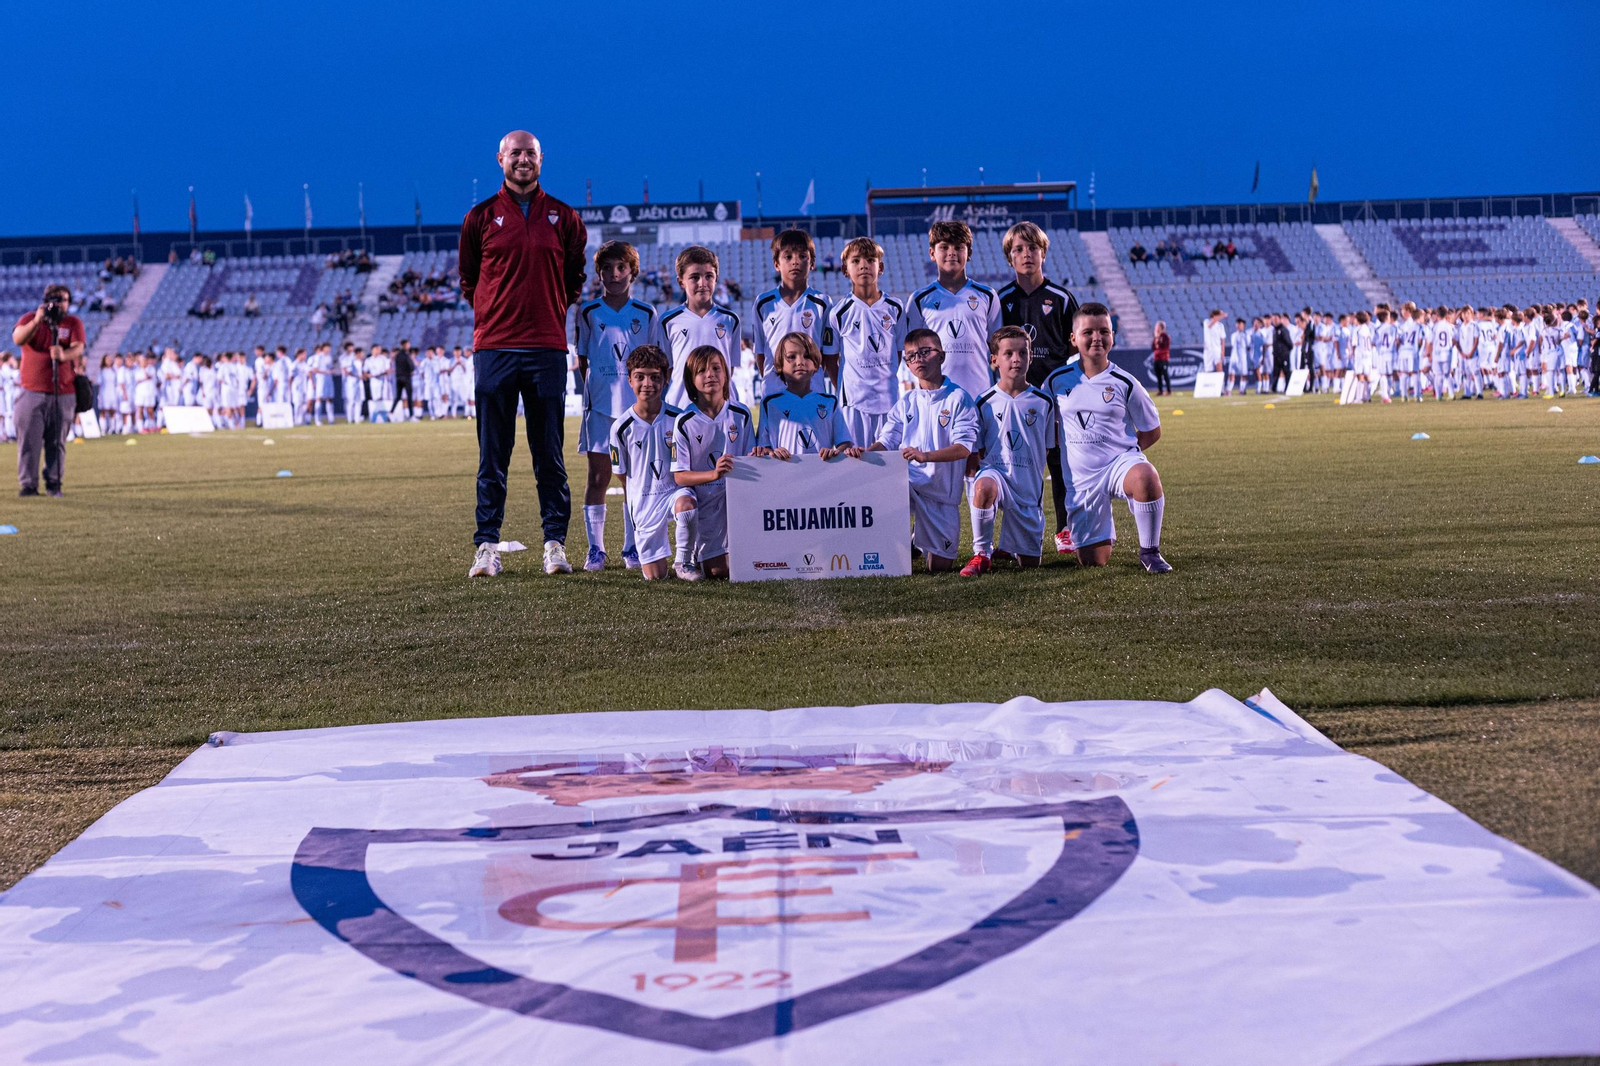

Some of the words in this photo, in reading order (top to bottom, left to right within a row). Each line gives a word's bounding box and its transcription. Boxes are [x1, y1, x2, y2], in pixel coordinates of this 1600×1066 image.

[636, 205, 668, 220] JAÉN
[670, 206, 708, 220] CLIMA
[1439, 331, 1447, 347] 9
[763, 502, 856, 531] BENJAMÍN
[862, 505, 874, 528] B
[631, 968, 793, 993] 1922
